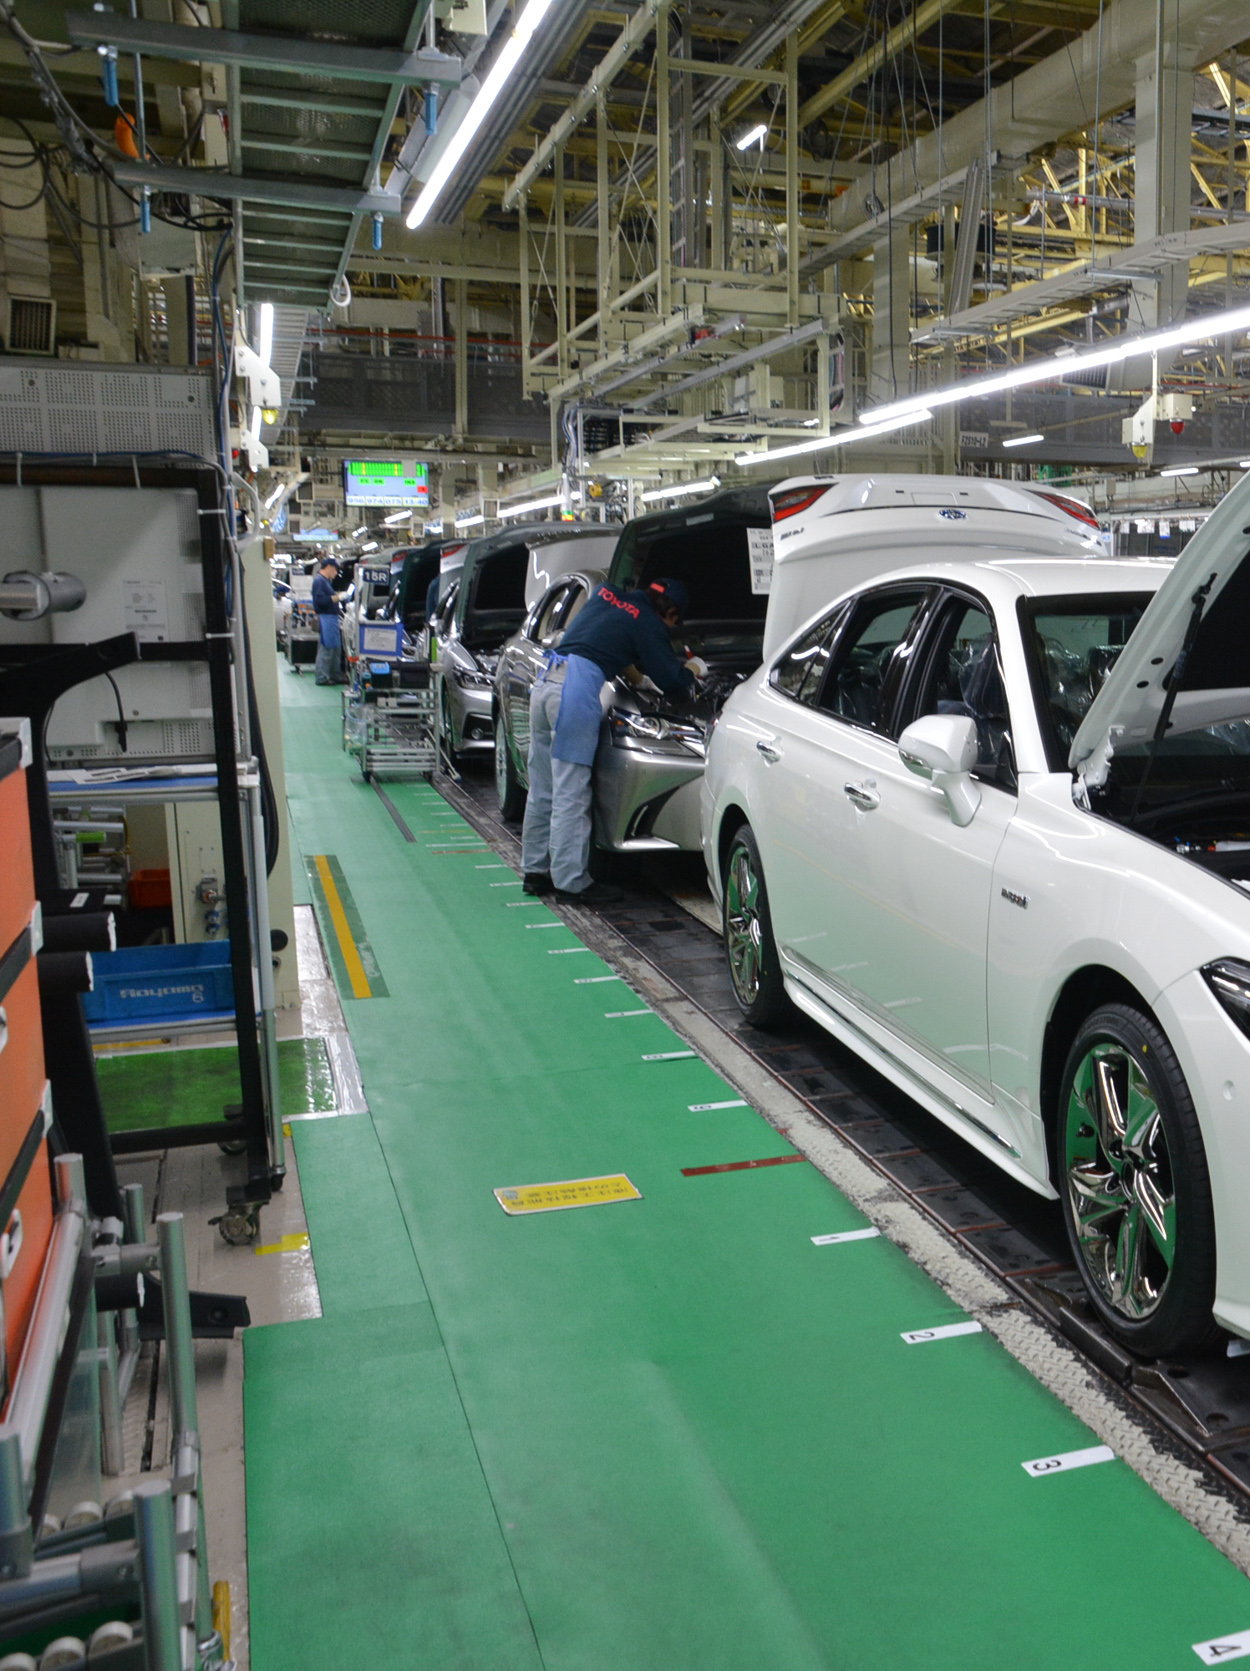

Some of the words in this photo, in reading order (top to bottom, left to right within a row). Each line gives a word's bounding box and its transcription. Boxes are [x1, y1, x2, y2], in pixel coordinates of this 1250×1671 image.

[364, 570, 388, 583] 15R
[598, 586, 640, 619] TOYOTA
[908, 1330, 936, 1342] 2
[1032, 1458, 1062, 1473] 3
[1208, 1641, 1242, 1658] 4
